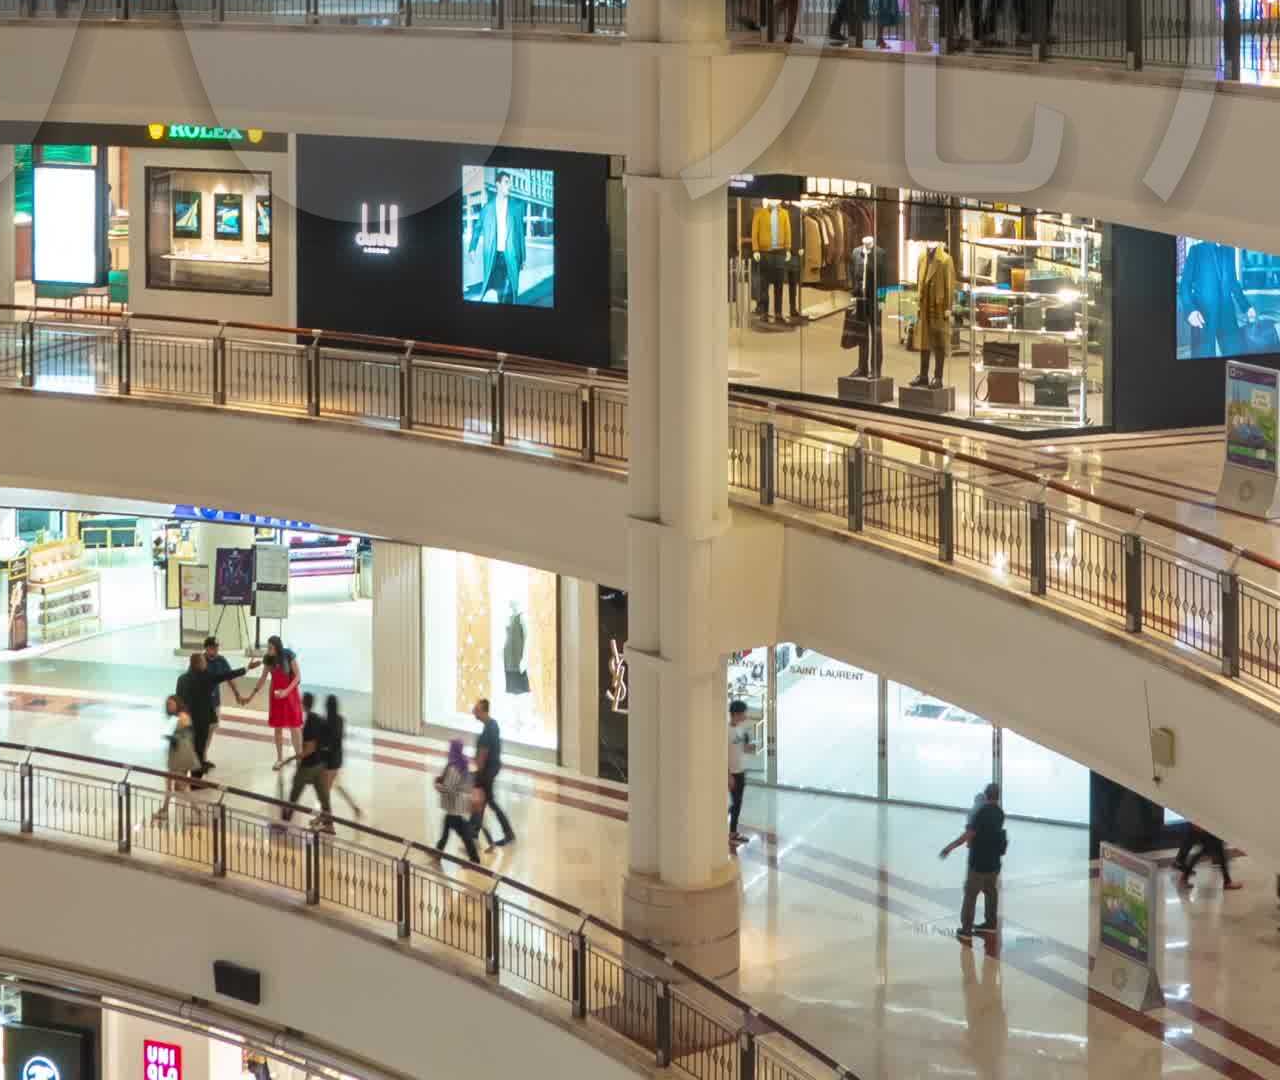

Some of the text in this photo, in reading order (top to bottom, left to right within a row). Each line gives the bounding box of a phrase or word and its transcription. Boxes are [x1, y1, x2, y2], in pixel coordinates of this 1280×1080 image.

[790, 665, 864, 681] SAINT LAURENT
[147, 1045, 175, 1067] UNI
